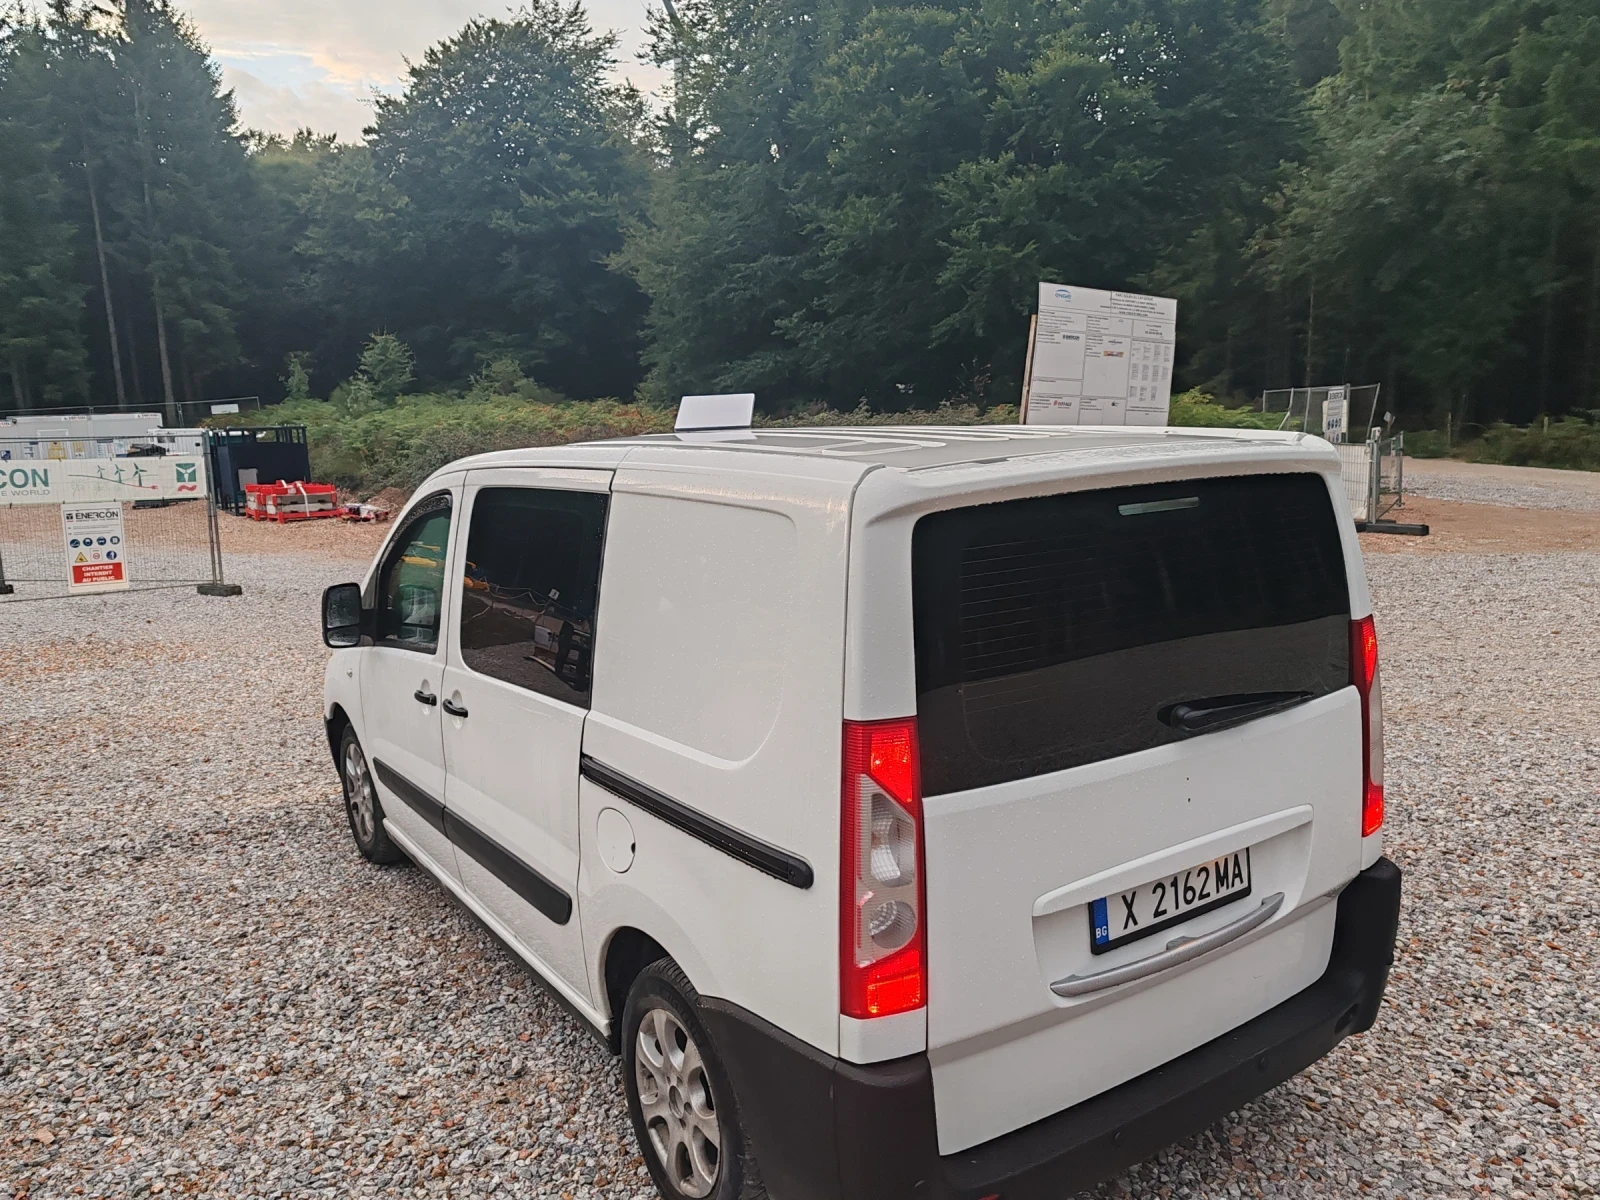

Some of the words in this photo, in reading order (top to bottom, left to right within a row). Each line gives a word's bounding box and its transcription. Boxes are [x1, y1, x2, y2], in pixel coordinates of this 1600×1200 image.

[75, 511, 119, 519] ENERCON
[82, 564, 114, 572] CHANTIER
[1121, 891, 1138, 930] X
[1095, 925, 1108, 939] BG
